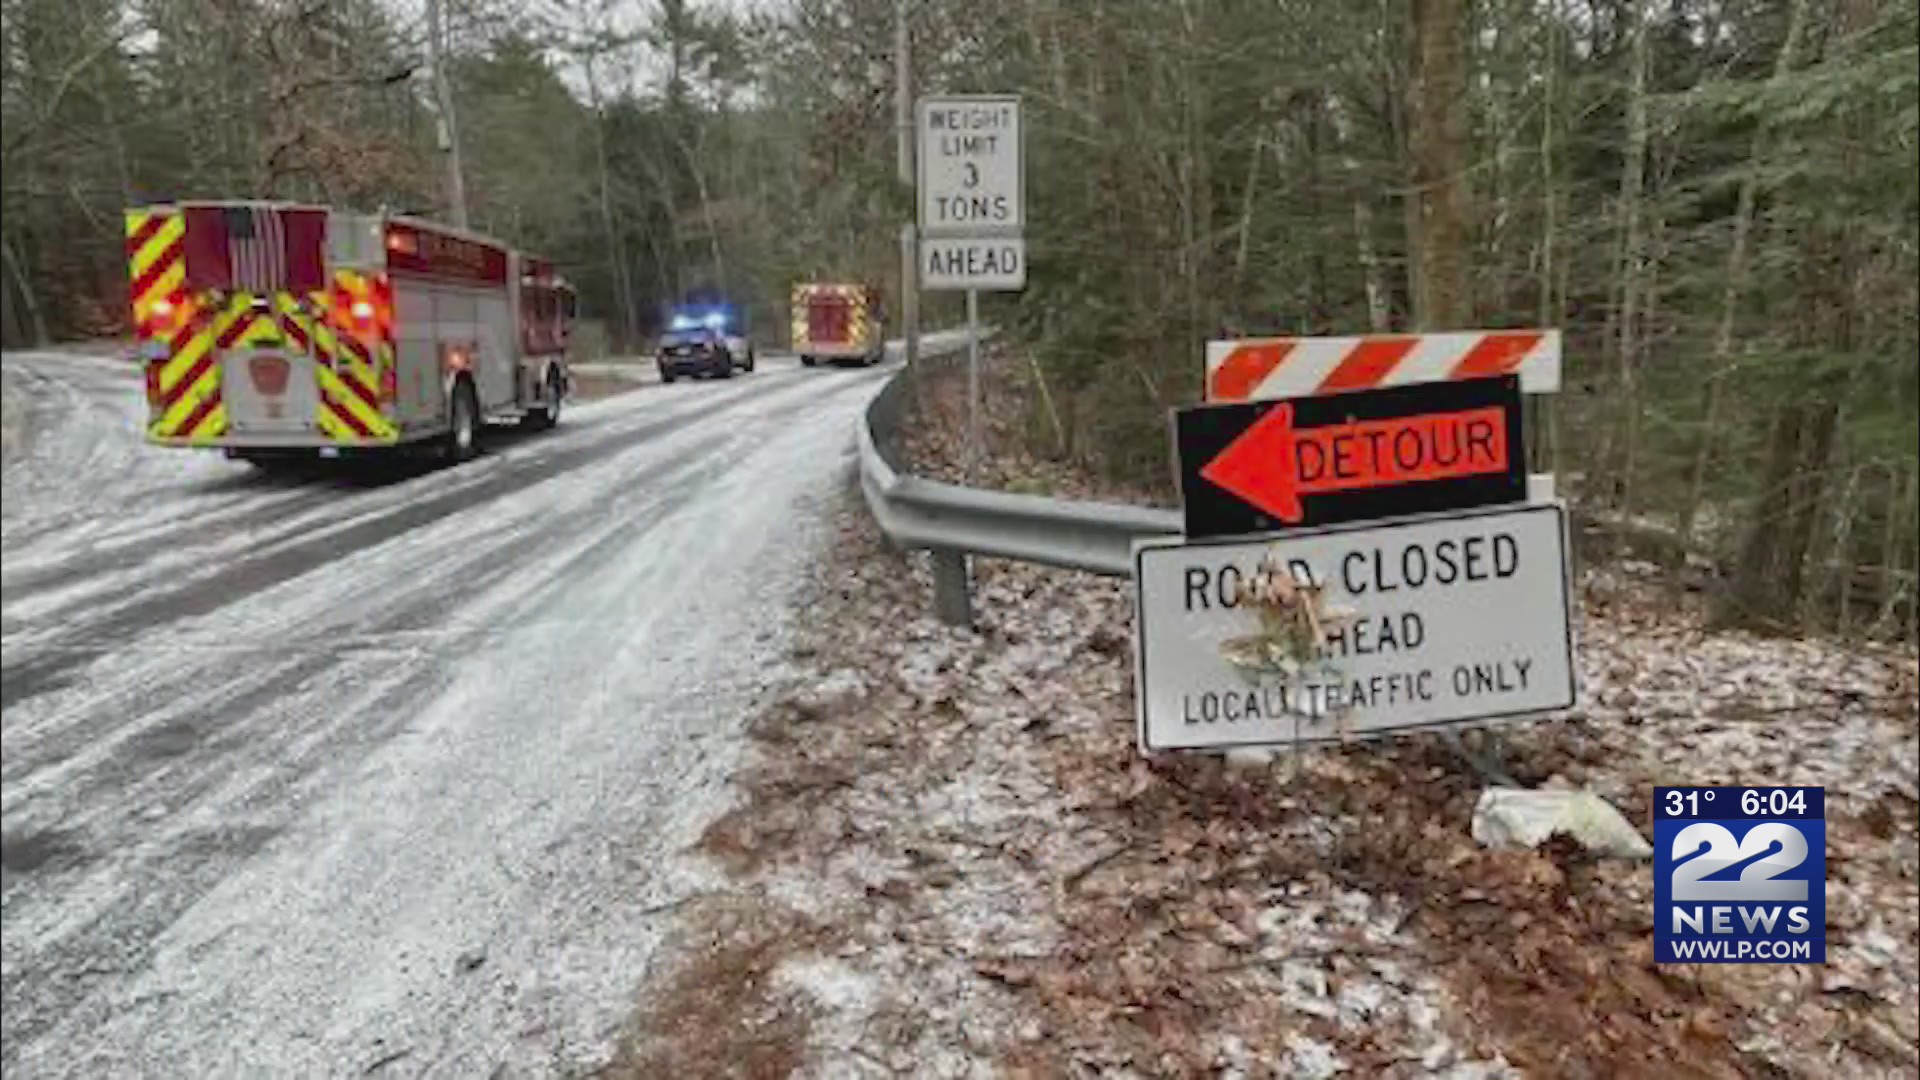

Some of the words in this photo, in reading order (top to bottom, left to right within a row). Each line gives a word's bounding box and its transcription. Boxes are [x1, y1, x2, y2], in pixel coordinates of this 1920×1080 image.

[929, 109, 1009, 129] WEIGHT
[942, 135, 998, 156] LIMIT
[964, 162, 980, 189] 3
[935, 197, 1008, 220] TONS
[929, 248, 1017, 274] AHEAD
[1295, 419, 1496, 484] DETOUR
[1184, 558, 1320, 612] ROD
[1342, 534, 1518, 597] CLOSED
[1310, 612, 1424, 659] HEAD
[1184, 686, 1286, 725] LOCAL
[1306, 670, 1432, 725] TRAFFIC
[1453, 658, 1533, 697] ONLY
